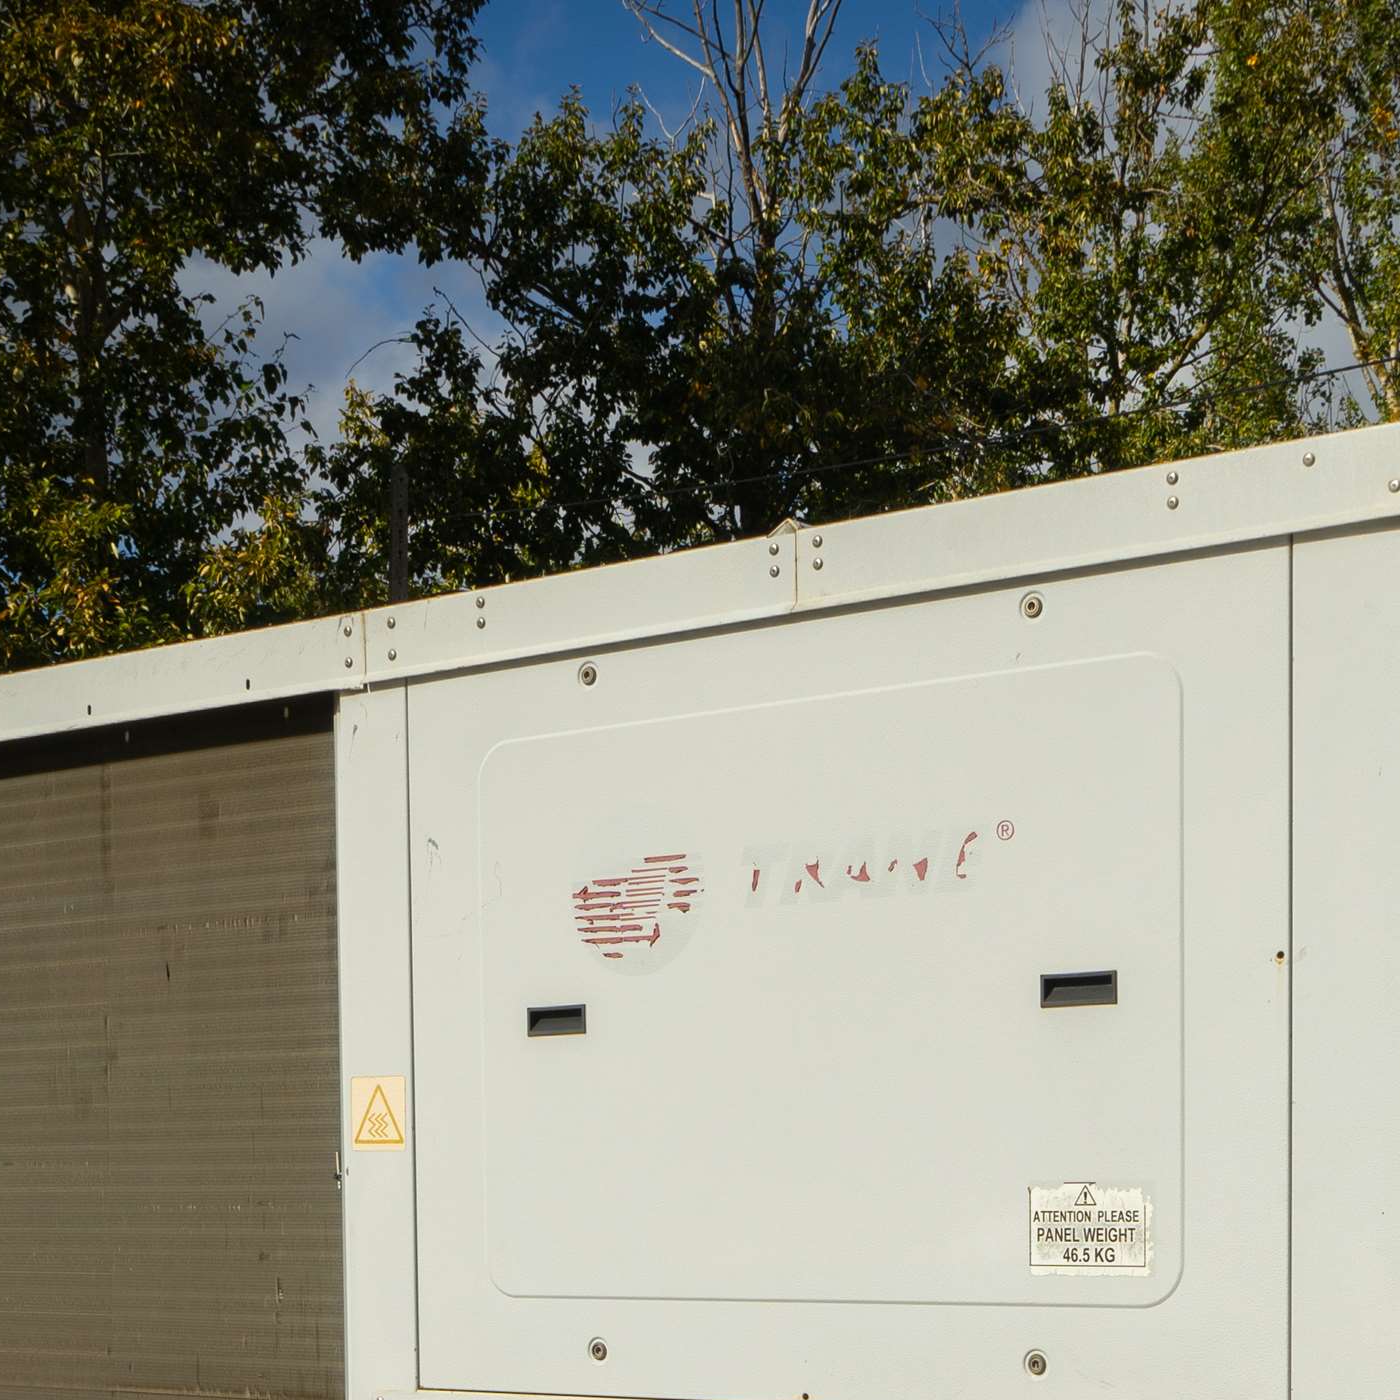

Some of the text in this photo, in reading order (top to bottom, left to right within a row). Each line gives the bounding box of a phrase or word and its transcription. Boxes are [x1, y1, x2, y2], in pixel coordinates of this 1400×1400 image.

[1033, 1210, 1140, 1223] ATTENTION PLEASE
[1036, 1227, 1136, 1243] PANEL WEIGHT
[1063, 1247, 1116, 1263] 46.5 KG
